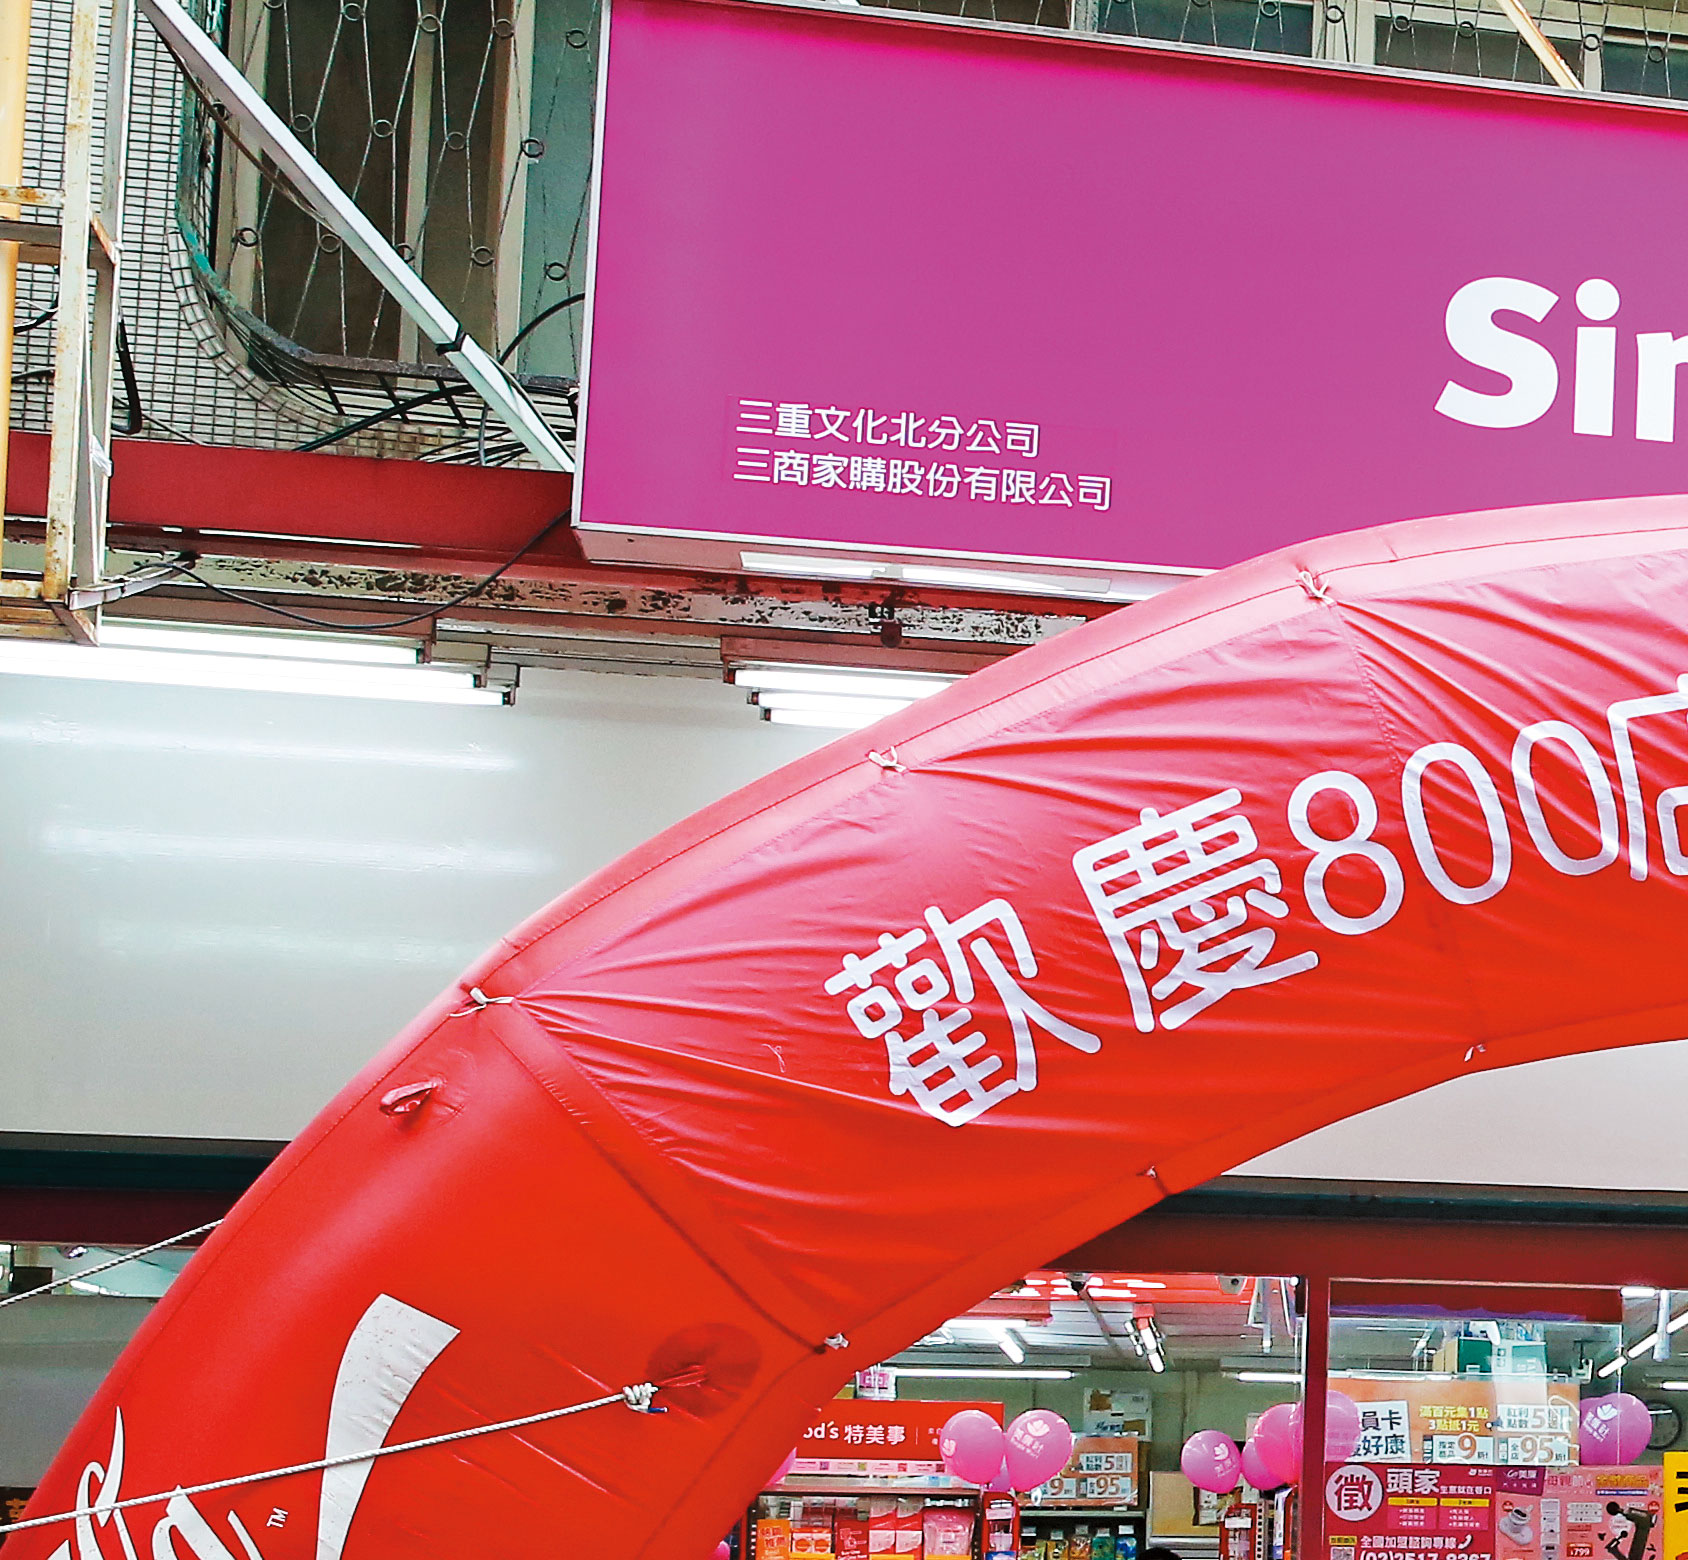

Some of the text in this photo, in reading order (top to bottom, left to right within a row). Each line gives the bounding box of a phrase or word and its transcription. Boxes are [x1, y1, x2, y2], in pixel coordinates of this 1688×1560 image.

[736, 398, 1042, 457] 三重文化北分公司
[732, 447, 1114, 512] 三商家購股份有限公司
[843, 1424, 906, 1445] 特美事
[1458, 1433, 1477, 1459] 9
[1520, 1435, 1554, 1464] 95
[1334, 1474, 1374, 1512] 徵
[1386, 1468, 1441, 1495] 頭家
